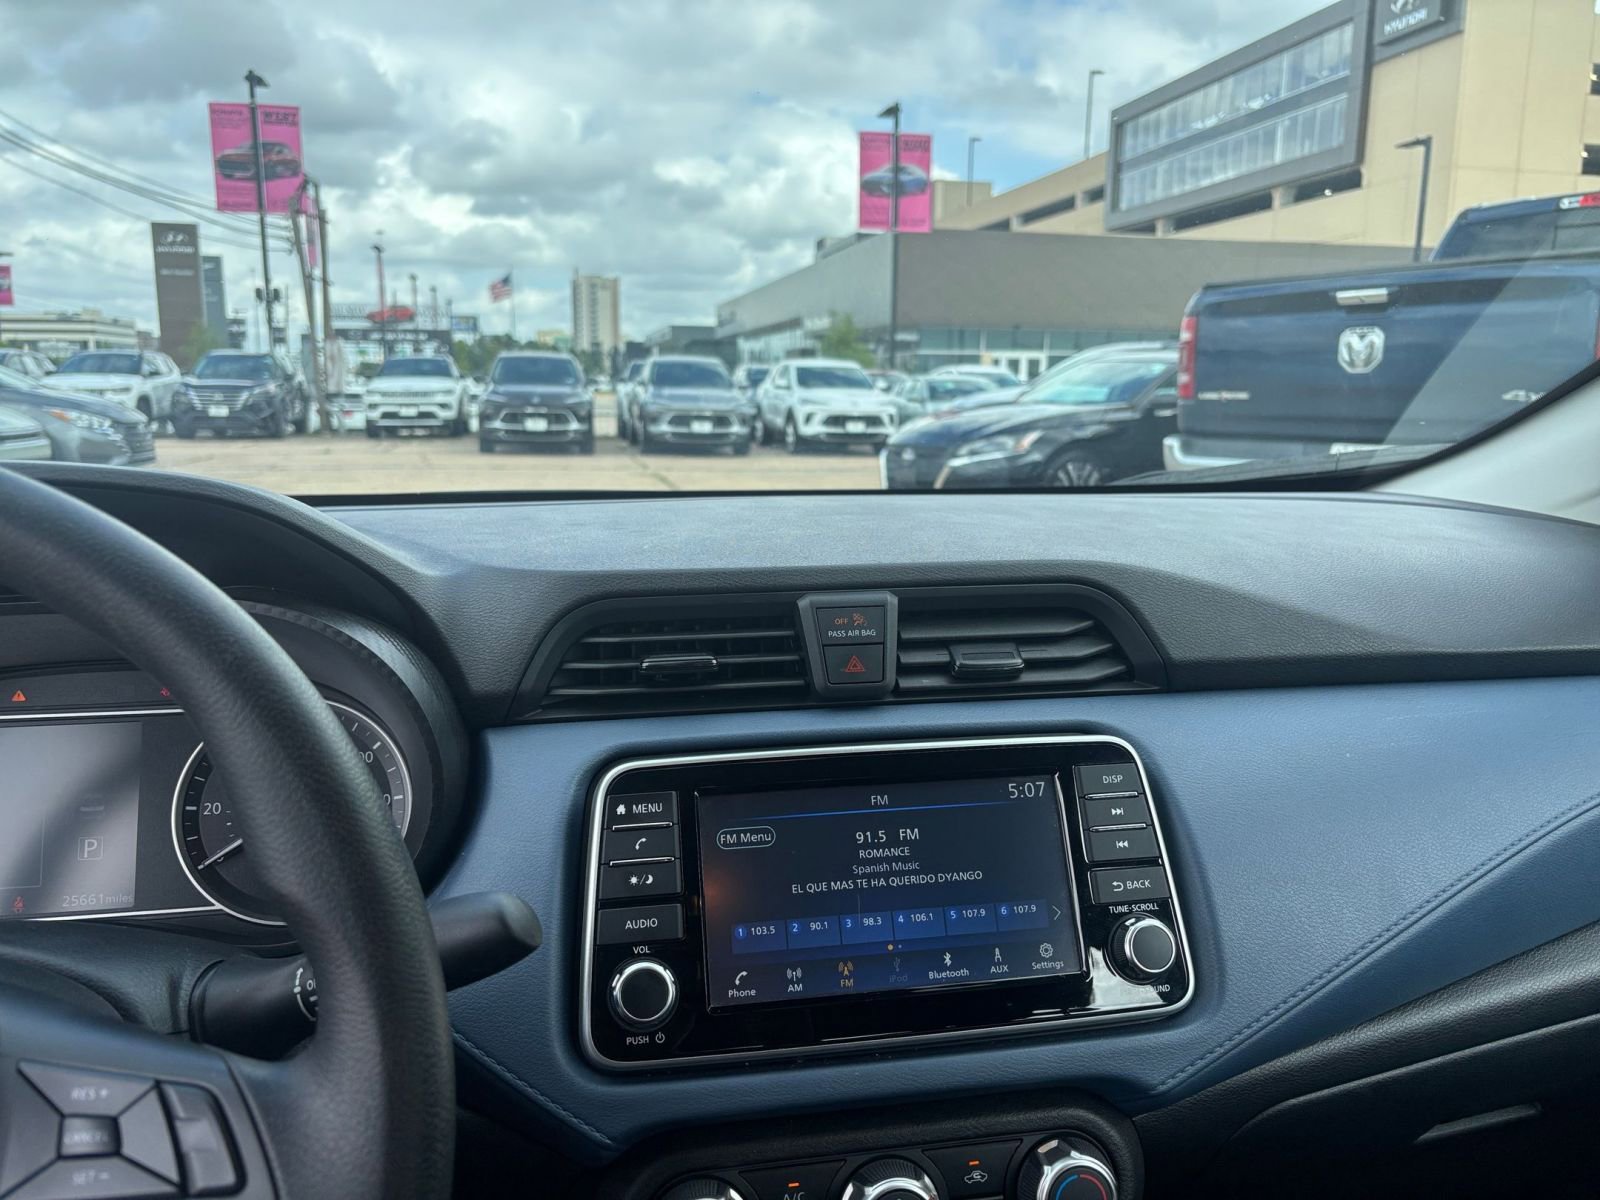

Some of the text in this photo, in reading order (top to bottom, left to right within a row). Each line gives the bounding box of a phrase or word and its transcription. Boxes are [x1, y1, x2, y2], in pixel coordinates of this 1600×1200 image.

[834, 617, 849, 625] OFF
[828, 628, 877, 638] PASS AIR BAG
[1102, 774, 1124, 784] DISP
[1008, 781, 1045, 799] 5:07
[870, 794, 889, 806] FM
[203, 802, 222, 815] 20
[632, 802, 663, 815] MENU
[720, 832, 772, 845] FM Menu
[856, 828, 920, 844] 91.5 FM
[83, 838, 98, 858] P
[859, 846, 911, 859] ROMANCE
[852, 861, 921, 876] Spanish Music
[792, 870, 983, 894] EL QUE MAS TE HA QUERIDO DYANGO
[1126, 879, 1152, 890] BACK
[950, 909, 986, 919] 5 107.9
[1001, 904, 1037, 915] 6 107.9
[625, 918, 658, 930] AUDIO
[845, 916, 882, 928] 3 98.3
[897, 913, 934, 924] 4 106.1
[738, 925, 776, 937] 1 103.5
[792, 921, 828, 933] 2 90.1
[632, 945, 651, 954] VOL
[990, 964, 1009, 974] AUX
[1031, 959, 1064, 970] Settings
[928, 967, 970, 980] Bluetooth
[787, 983, 803, 992] AM
[840, 978, 854, 988] FM
[728, 988, 757, 998] Phone
[626, 1035, 649, 1046] PUSH
